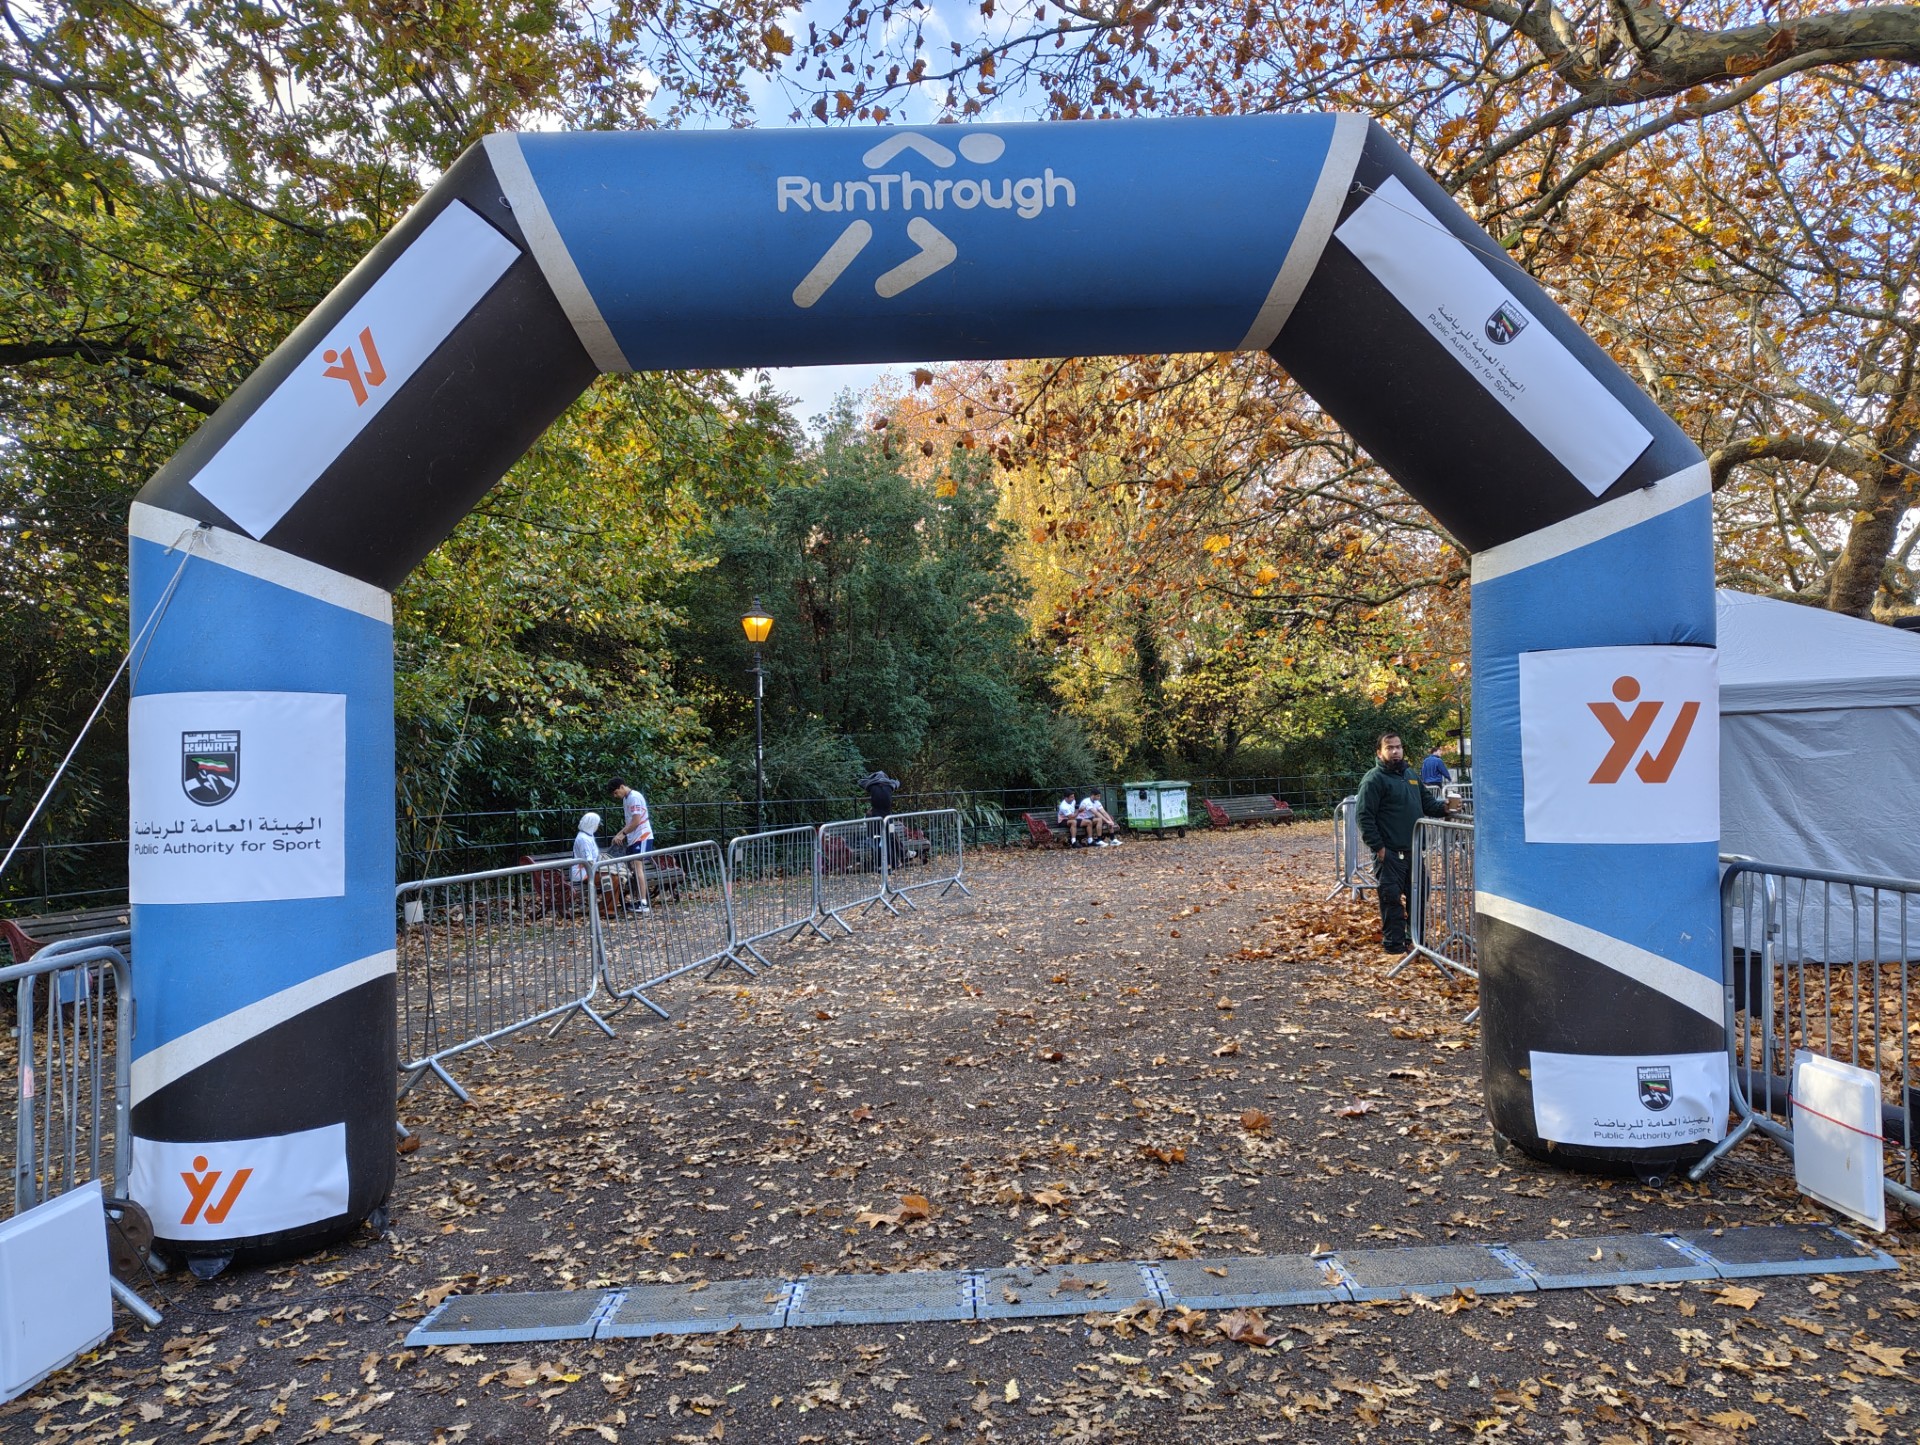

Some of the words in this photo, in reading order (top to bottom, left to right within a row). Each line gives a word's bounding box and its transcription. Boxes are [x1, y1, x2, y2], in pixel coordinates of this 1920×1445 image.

[777, 167, 1076, 219] RunThrough
[1438, 304, 1473, 340] للرياضة
[1428, 313, 1449, 336] Public
[1450, 337, 1483, 369] Authority
[1483, 368, 1495, 380] for
[1494, 380, 1515, 402] Sport
[1473, 338, 1500, 367] العامة
[184, 742, 238, 752] KUWAIT
[134, 820, 185, 839] للرياضة
[190, 818, 253, 833] العامة
[259, 816, 322, 835] الهيئة
[134, 844, 158, 855] Public
[163, 842, 235, 855] Authority
[240, 840, 266, 851] for
[272, 838, 321, 852] Sport
[1593, 1118, 1643, 1130] للرياضة
[1647, 1117, 1680, 1128] العامة
[1593, 1131, 1624, 1139] Public
[1628, 1131, 1672, 1140] Authority
[1688, 1127, 1711, 1136] Sport
